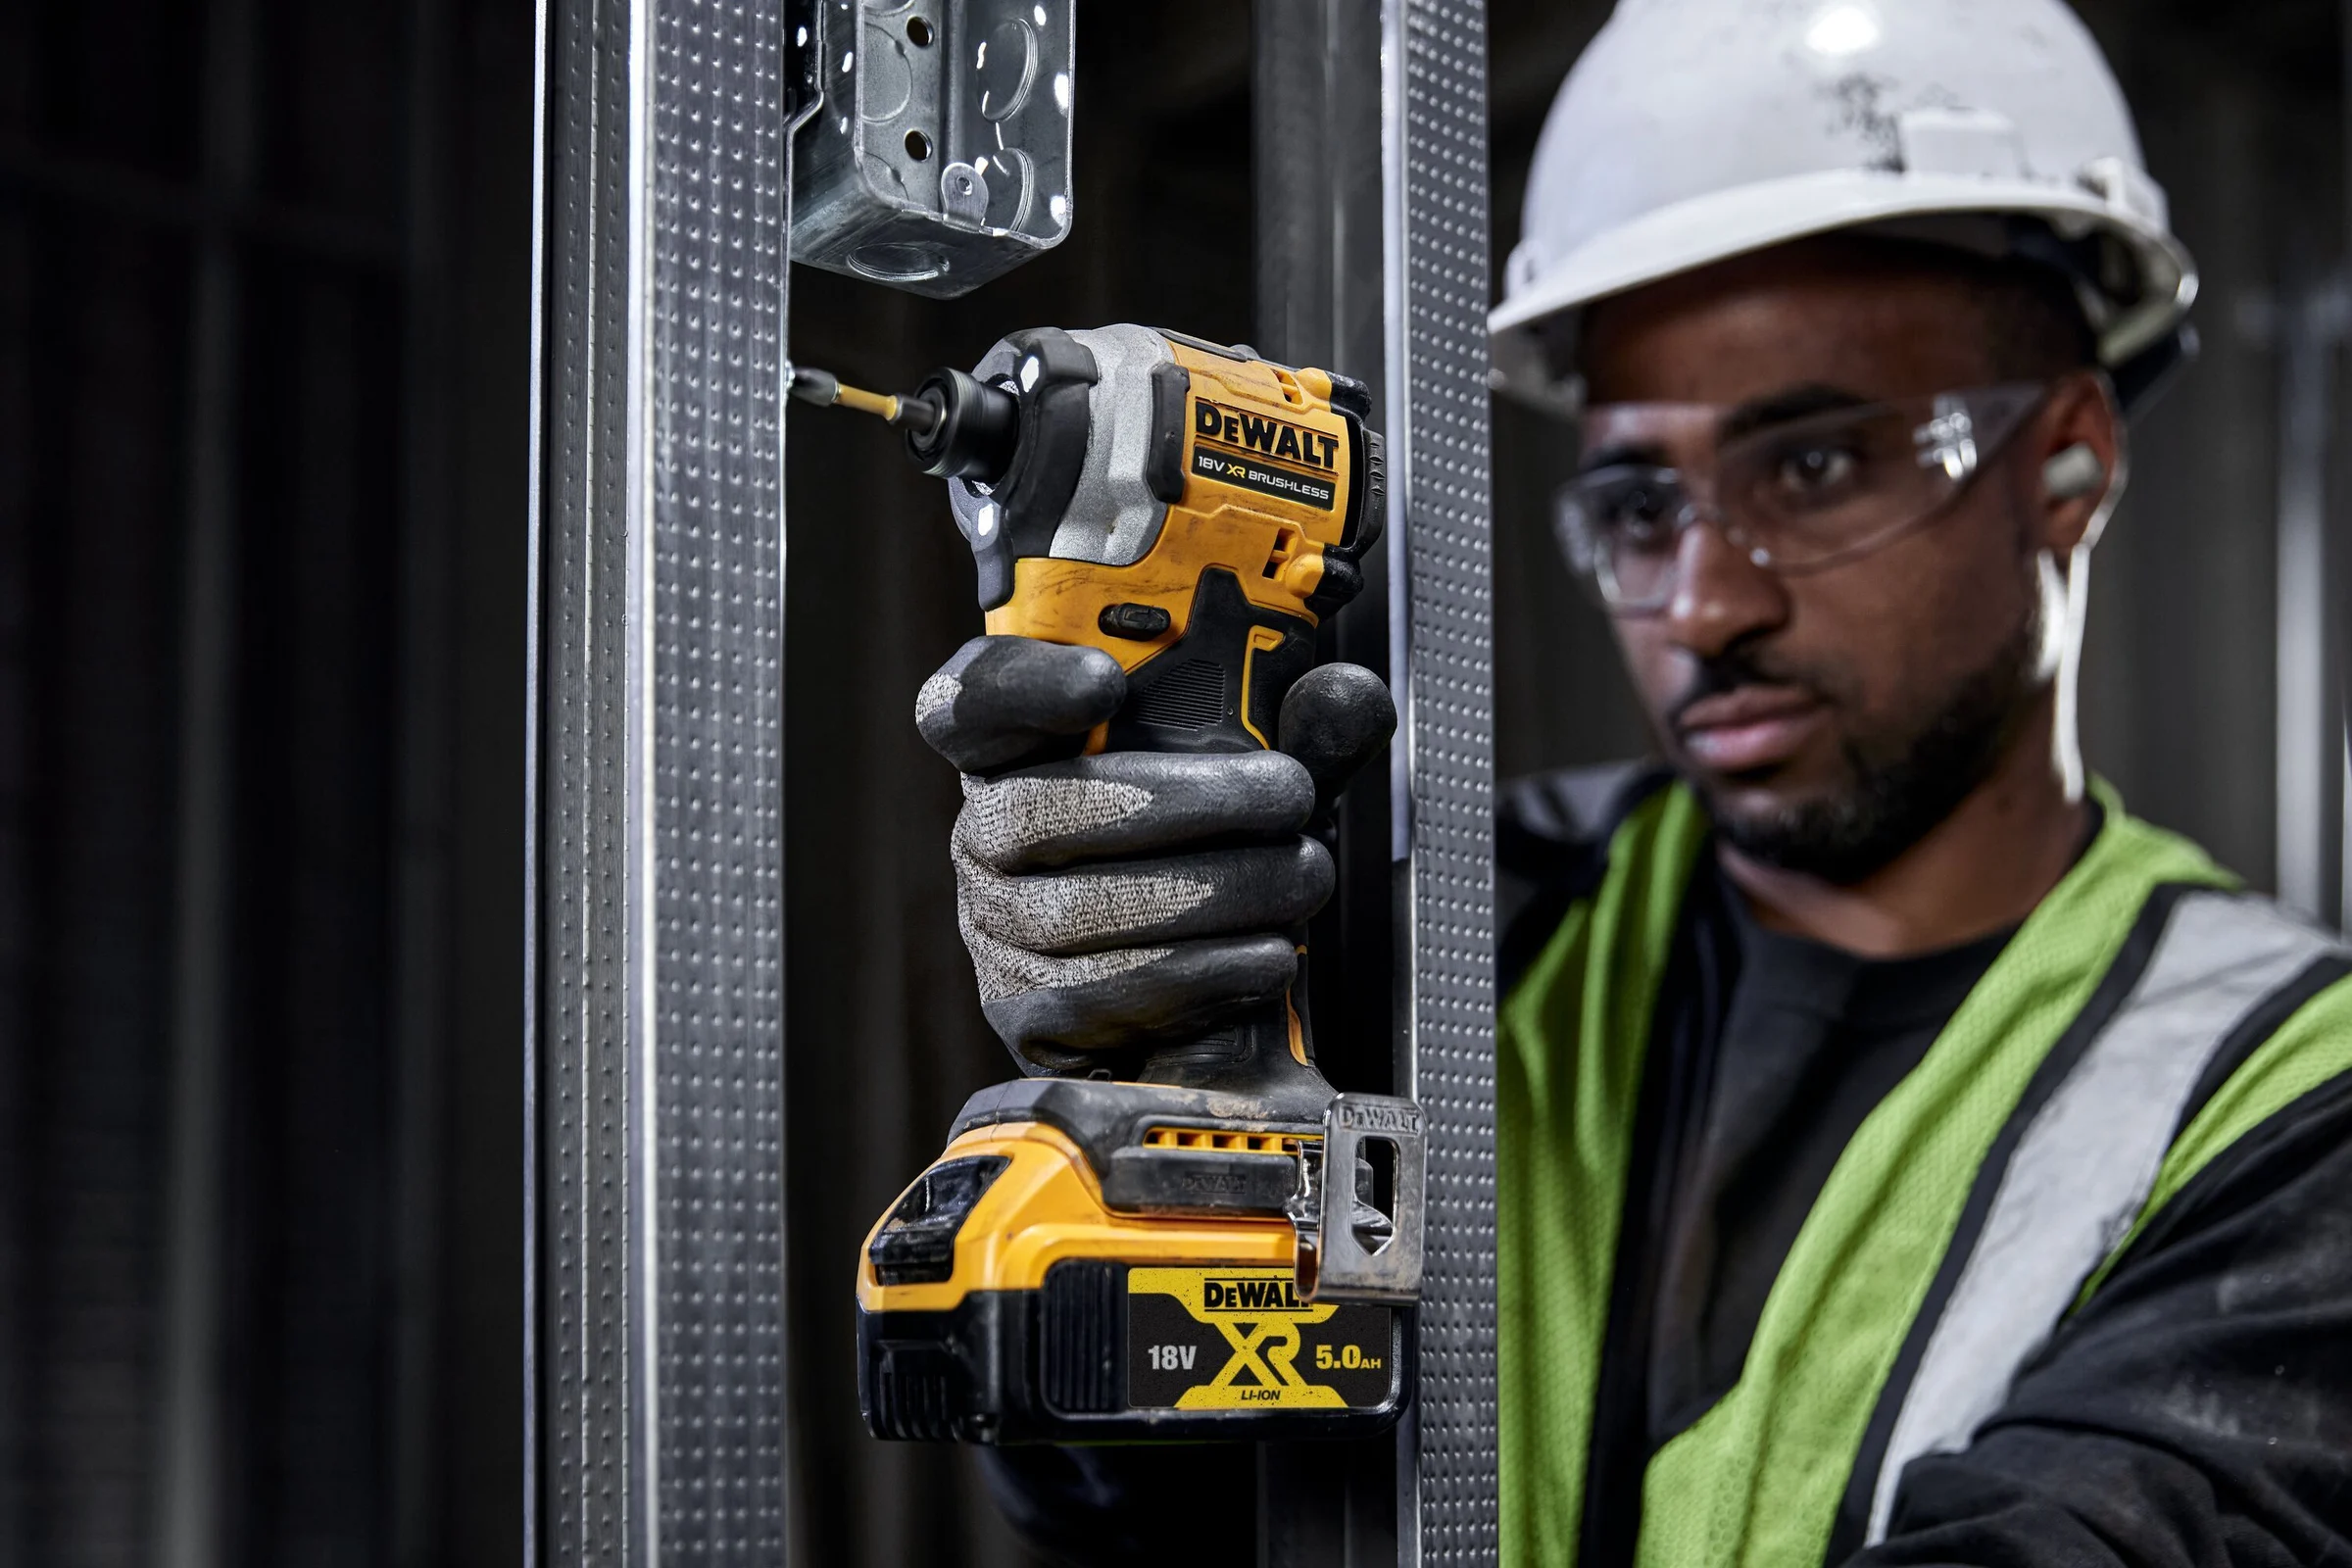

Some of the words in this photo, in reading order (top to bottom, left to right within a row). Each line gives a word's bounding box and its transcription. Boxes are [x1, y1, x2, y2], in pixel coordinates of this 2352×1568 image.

[1198, 455, 1225, 472] 18V
[1226, 463, 1247, 479] XR
[1248, 469, 1330, 501] BRUSHLESS
[1203, 1282, 1311, 1308] DEWAL
[1148, 1345, 1197, 1370] 18V
[1209, 1322, 1306, 1387] XR
[1241, 1390, 1281, 1401] LI-ION
